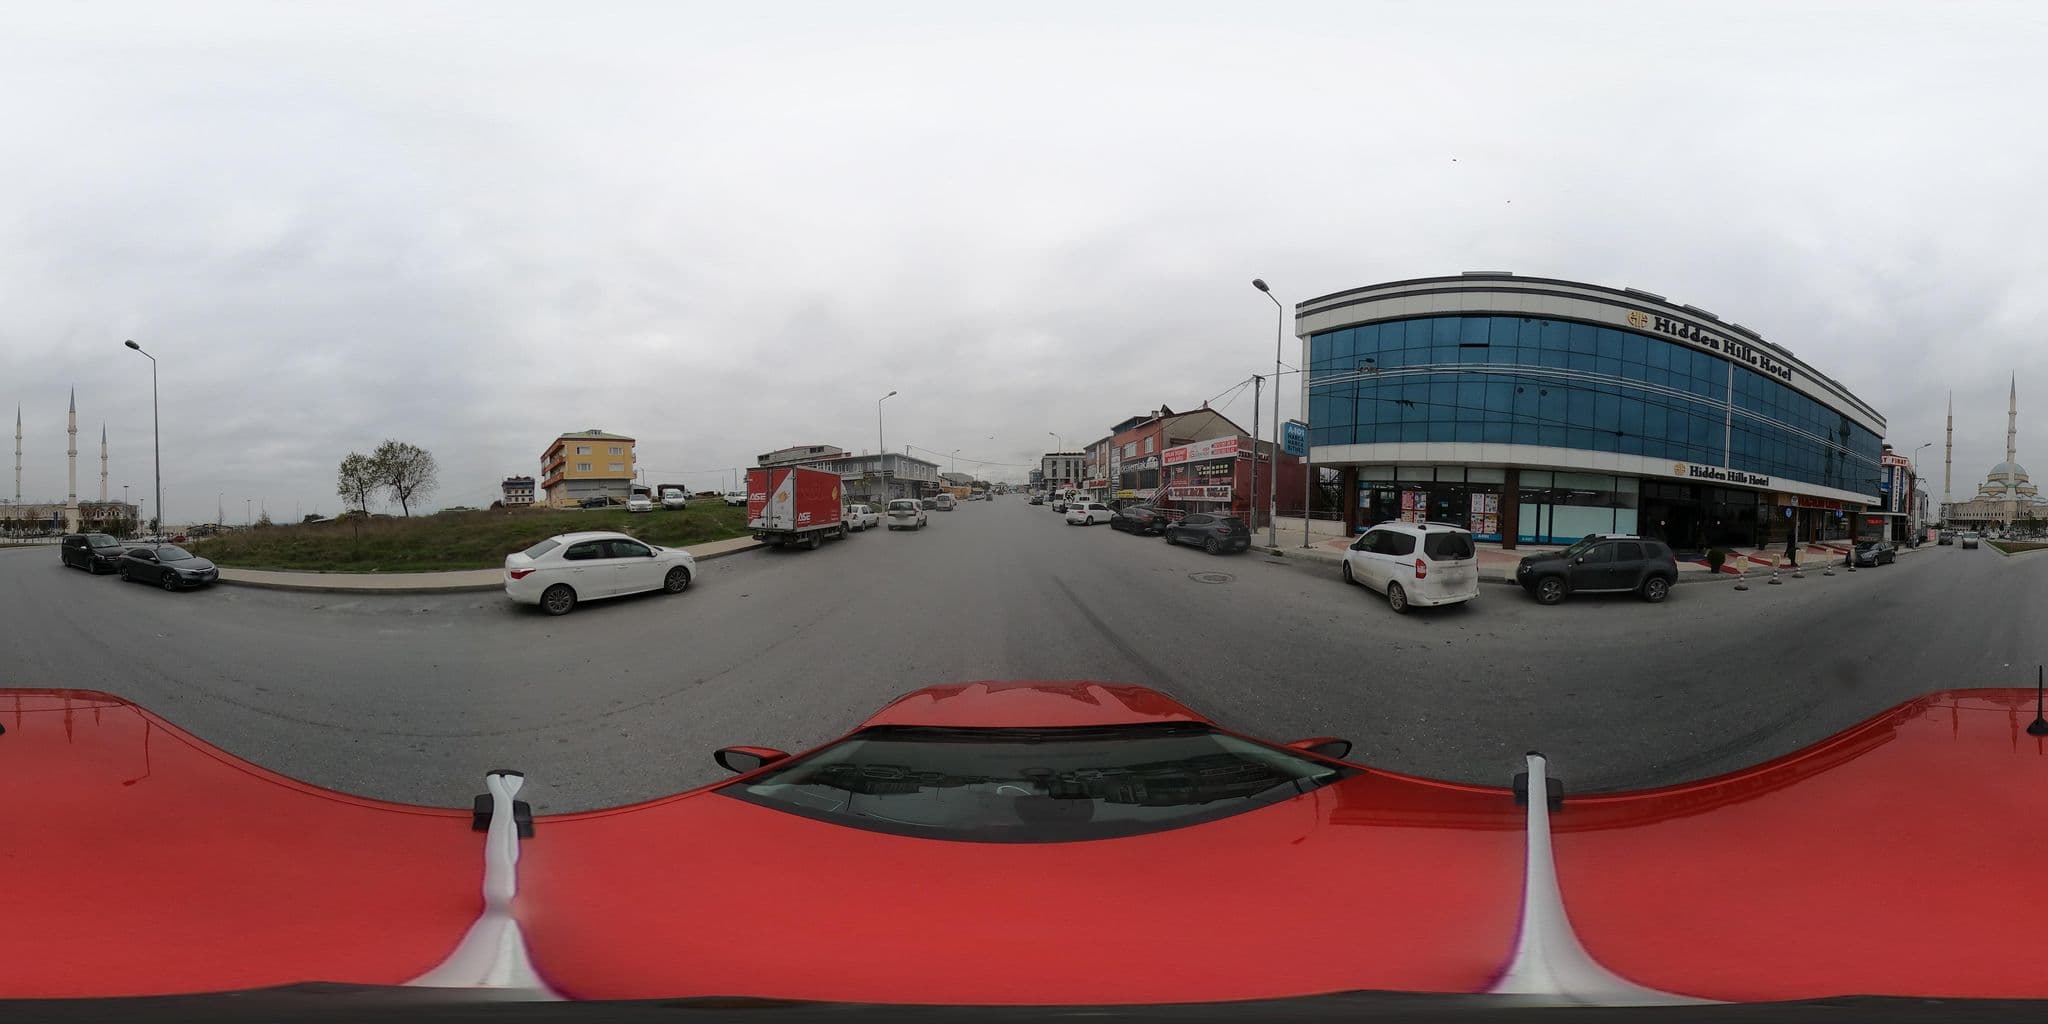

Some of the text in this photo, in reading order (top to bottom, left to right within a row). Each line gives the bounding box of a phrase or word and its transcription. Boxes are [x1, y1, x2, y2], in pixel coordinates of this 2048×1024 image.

[1654, 316, 1793, 382] Hidden Hills Hotel
[1689, 465, 1769, 487] Hidden Hills Hotel
[797, 511, 812, 522] ASE
